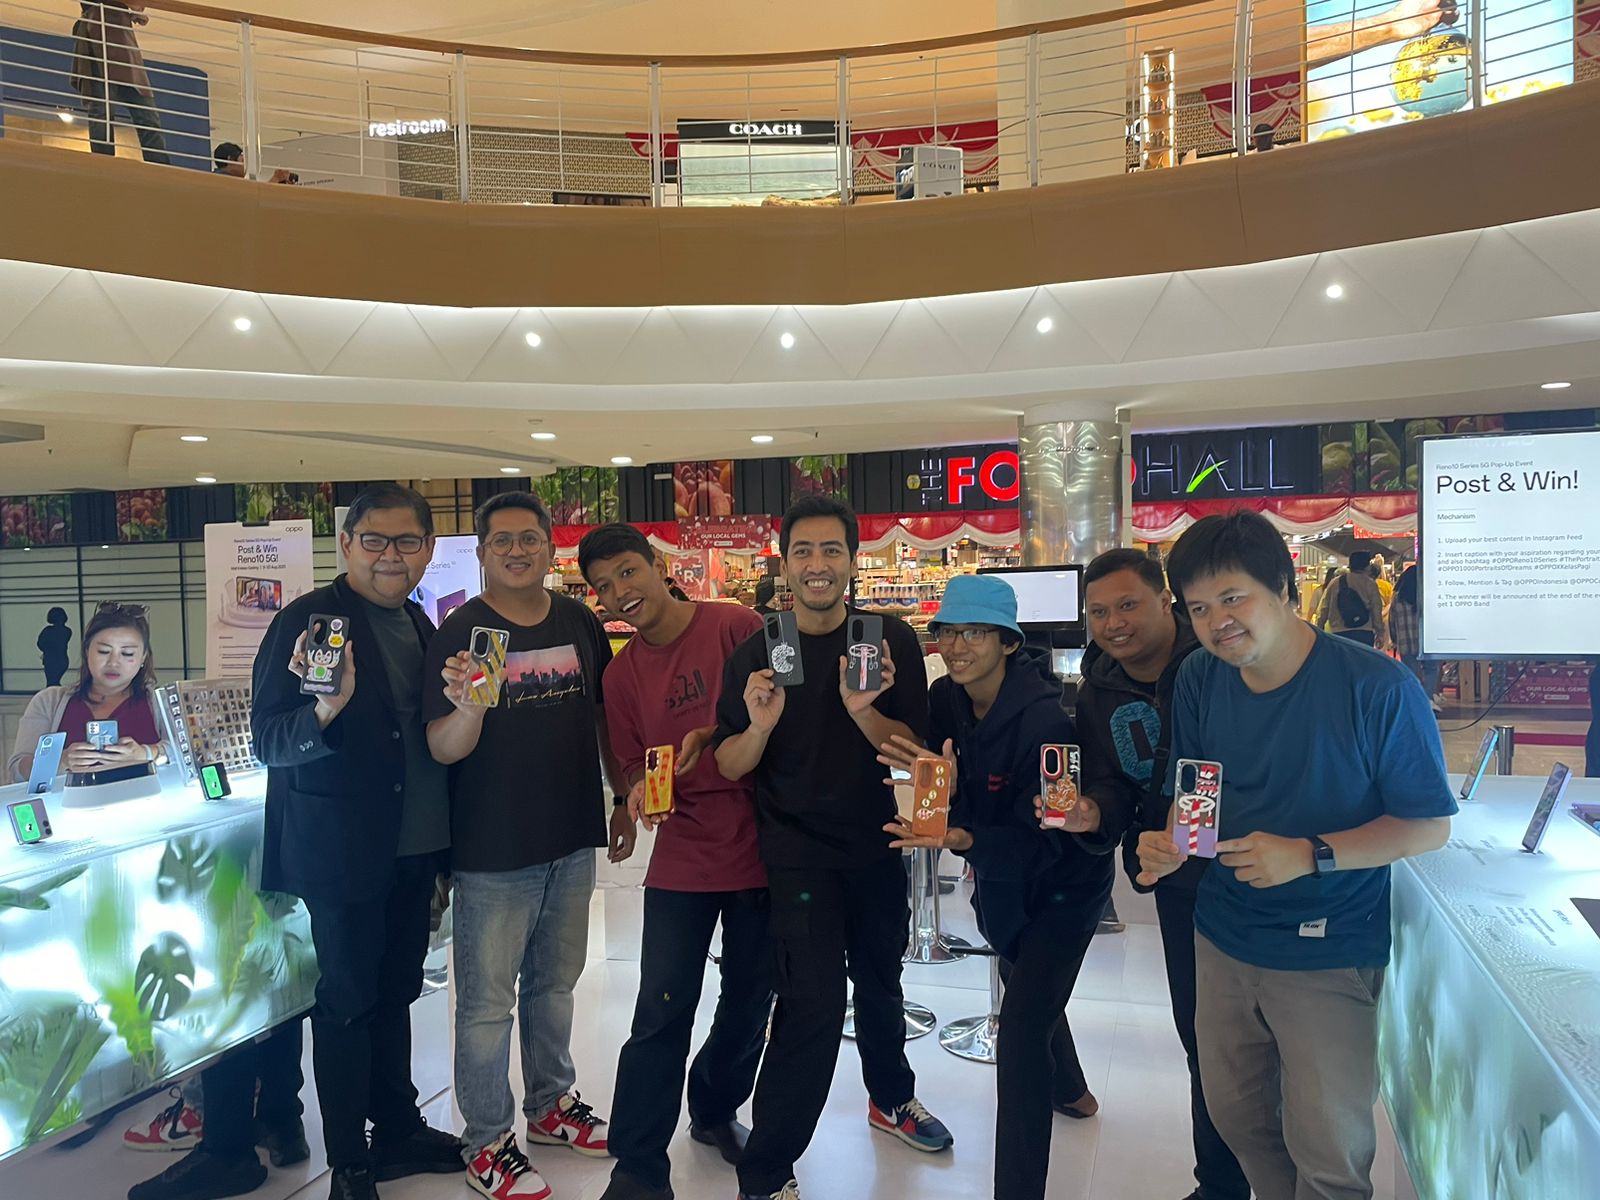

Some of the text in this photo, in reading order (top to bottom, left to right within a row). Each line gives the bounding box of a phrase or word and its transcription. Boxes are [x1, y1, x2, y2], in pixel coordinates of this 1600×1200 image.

[729, 123, 802, 135] COACH
[1437, 469, 1578, 494] Post & Win!
[1437, 512, 1476, 520] Mechanism
[238, 544, 278, 554] Post & Win
[237, 554, 264, 563] Reno10
